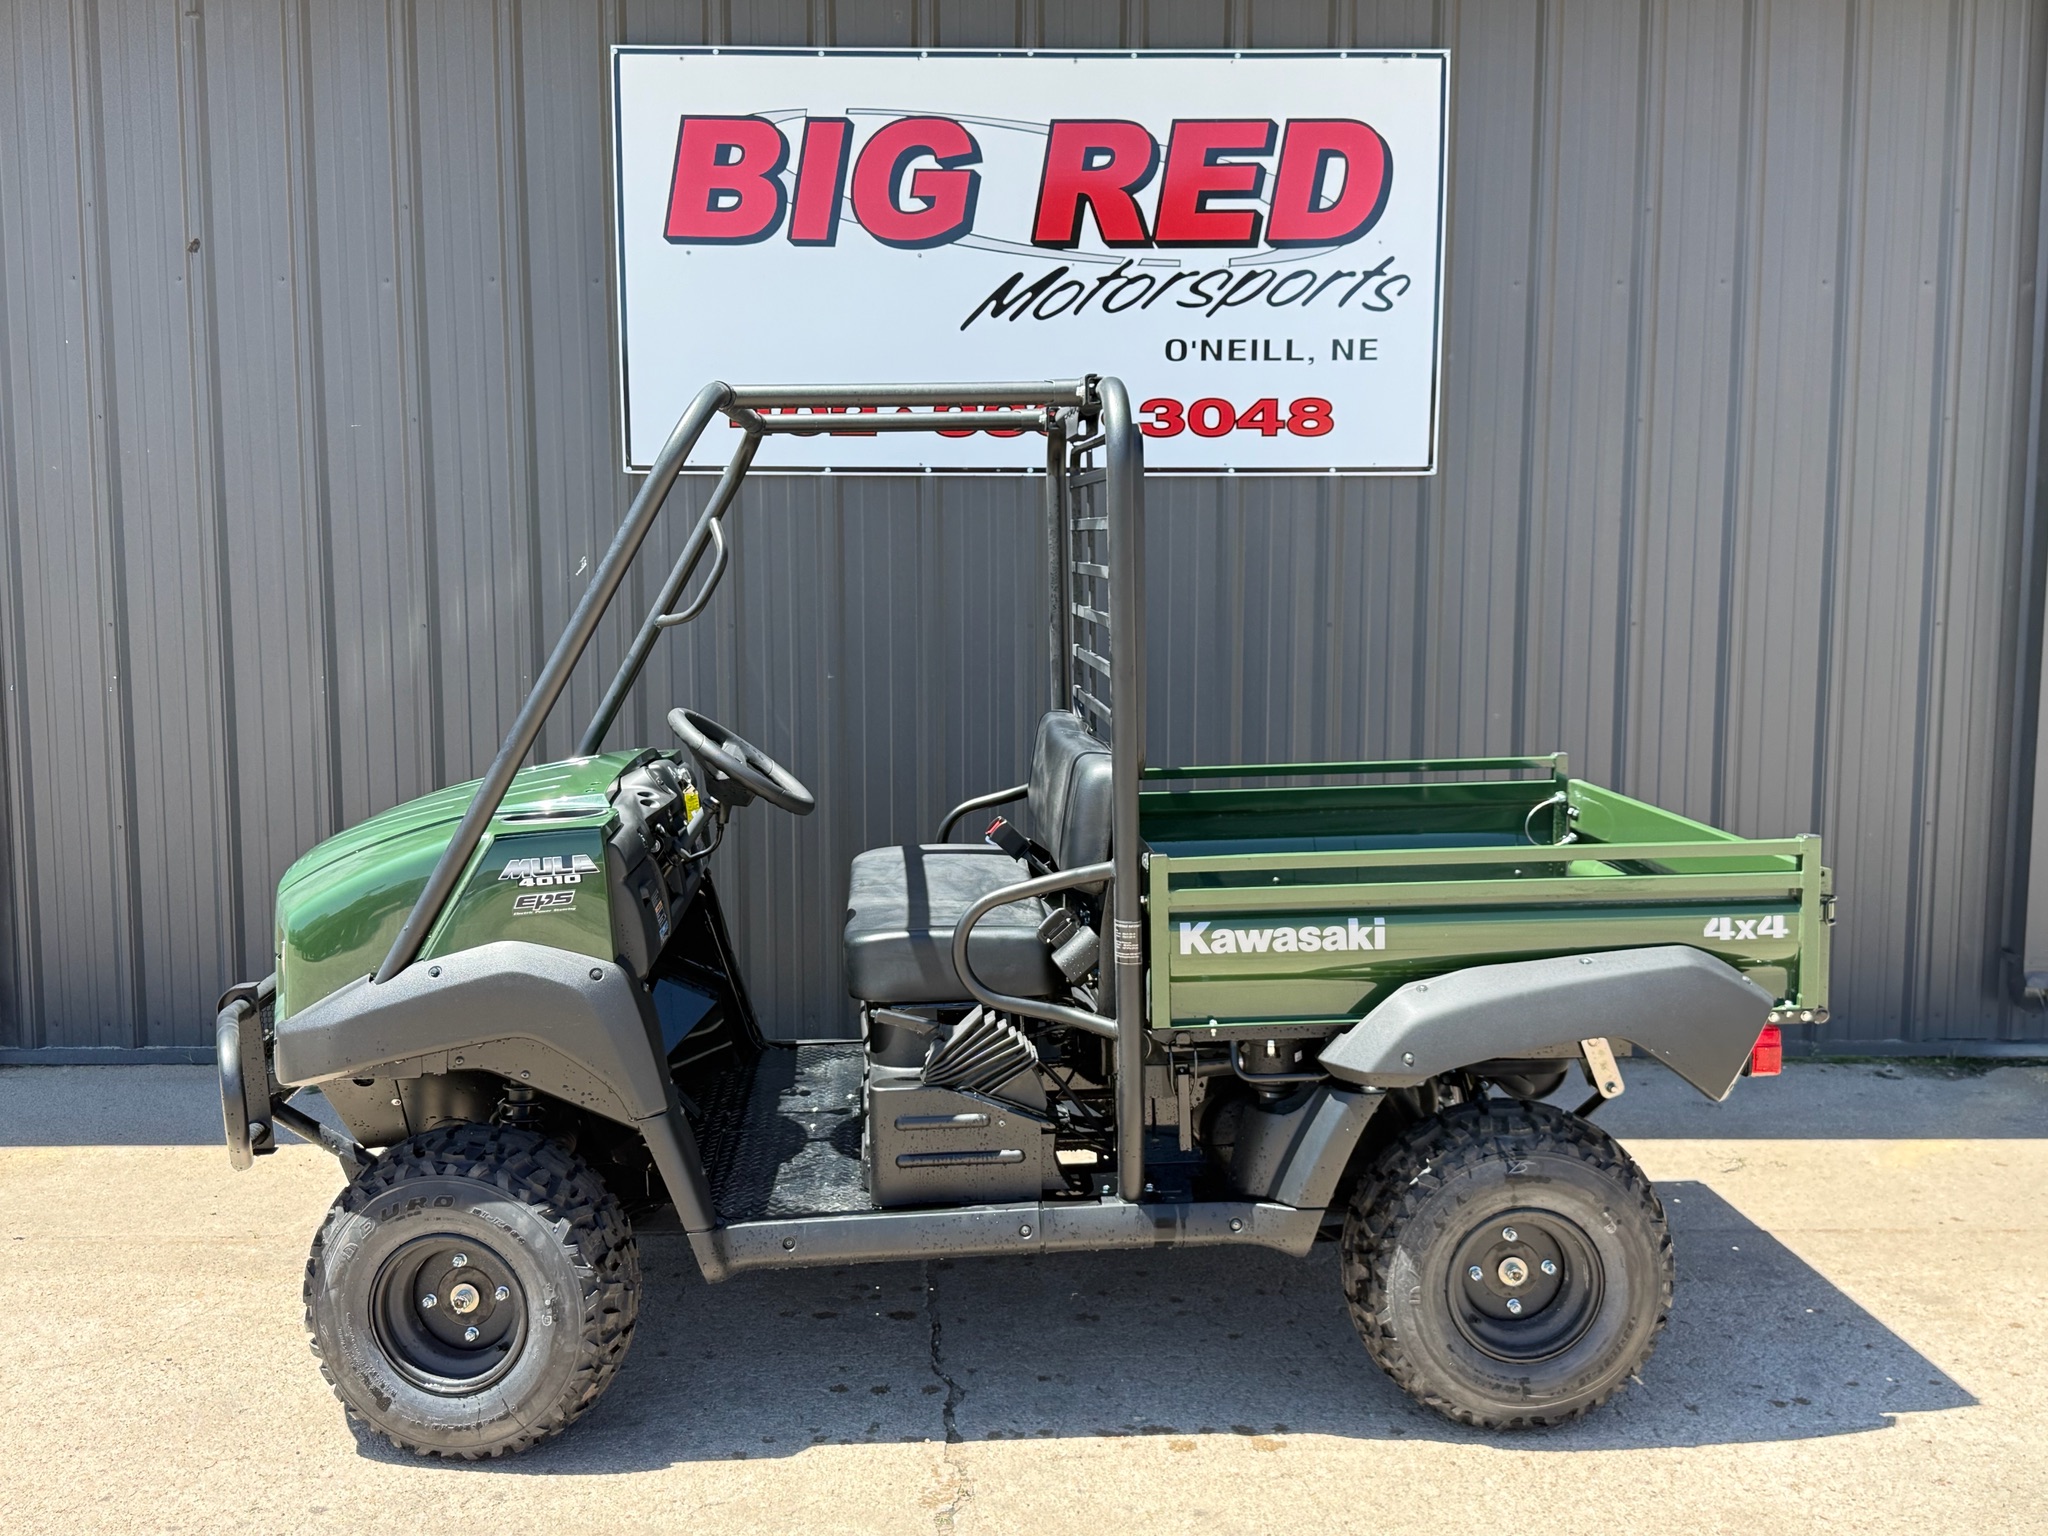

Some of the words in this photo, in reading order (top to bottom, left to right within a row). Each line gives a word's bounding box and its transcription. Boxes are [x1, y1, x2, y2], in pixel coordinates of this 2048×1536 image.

[663, 115, 983, 250] BIG
[1031, 118, 1394, 249] RED
[960, 256, 1412, 332] Motorsports
[1164, 338, 1315, 366] O'NEILL,
[1331, 338, 1379, 361] NE
[1139, 397, 1334, 437] 3048
[498, 853, 600, 880] MULE
[518, 874, 581, 887] 4010
[1179, 917, 1386, 955] Kawasaki
[1703, 915, 1790, 940] 4x4
